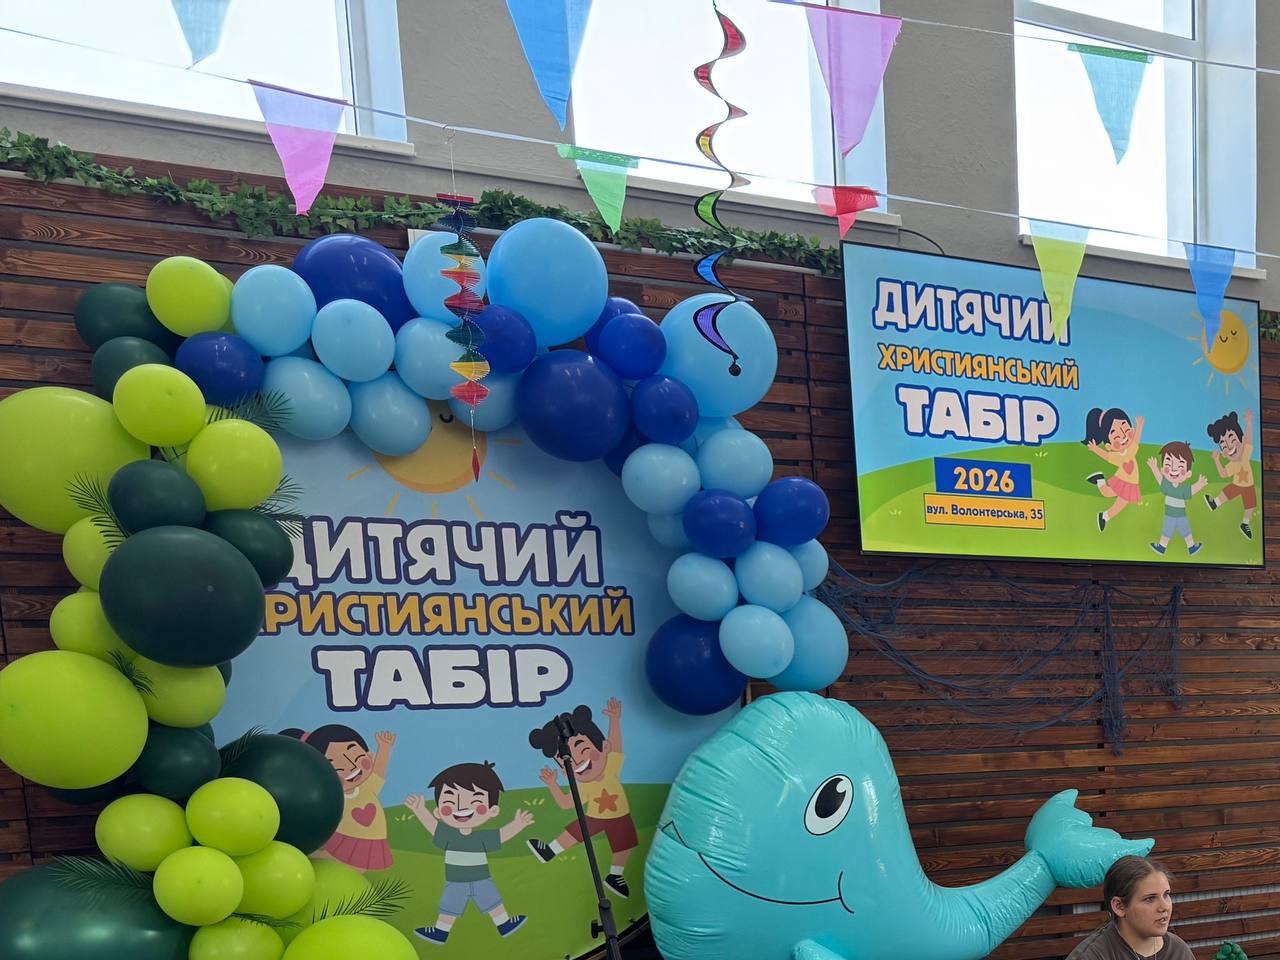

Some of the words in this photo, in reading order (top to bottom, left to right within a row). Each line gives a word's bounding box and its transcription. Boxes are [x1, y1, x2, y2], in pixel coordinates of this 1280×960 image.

[878, 343, 1079, 390] ХРИСТИЯНСЬКИЙ
[896, 384, 1059, 446] ТАБІР
[953, 466, 1015, 493] 2026
[926, 504, 949, 515] вул.
[951, 504, 1028, 520] Волонтерська,
[1030, 508, 1043, 520] 35
[262, 586, 634, 636] РИСТИЯНСЬКИЙ
[312, 645, 573, 711] ТАБІР
